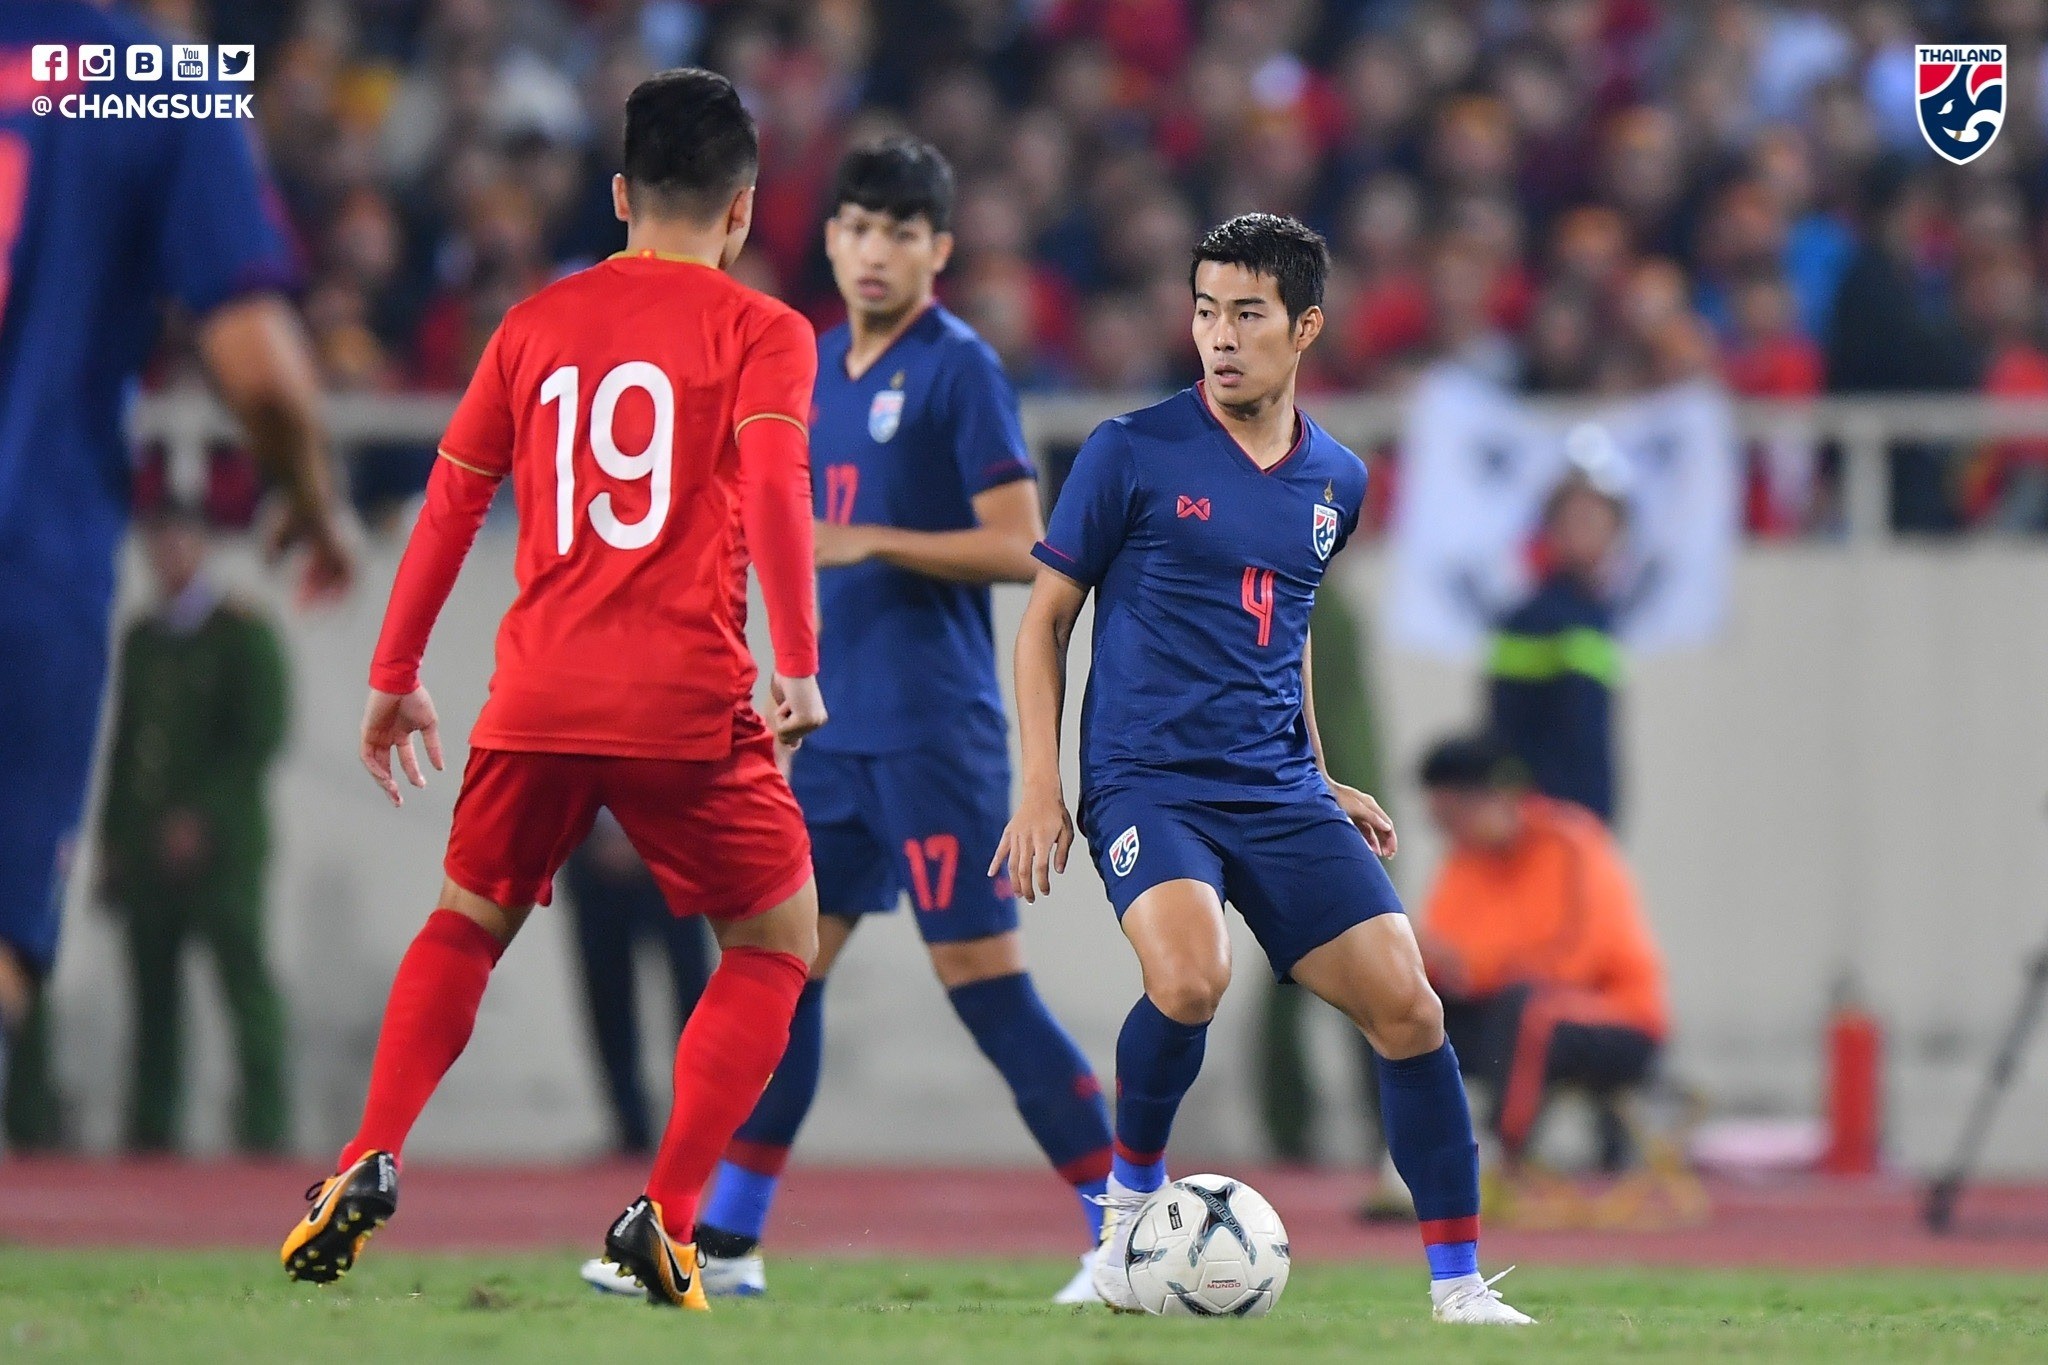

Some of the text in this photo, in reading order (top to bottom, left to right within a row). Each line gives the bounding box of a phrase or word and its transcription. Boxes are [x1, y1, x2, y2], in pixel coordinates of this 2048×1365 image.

[540, 360, 675, 556] 19
[825, 462, 860, 526] 17
[1241, 566, 1276, 647] 4
[904, 833, 959, 911] 17
